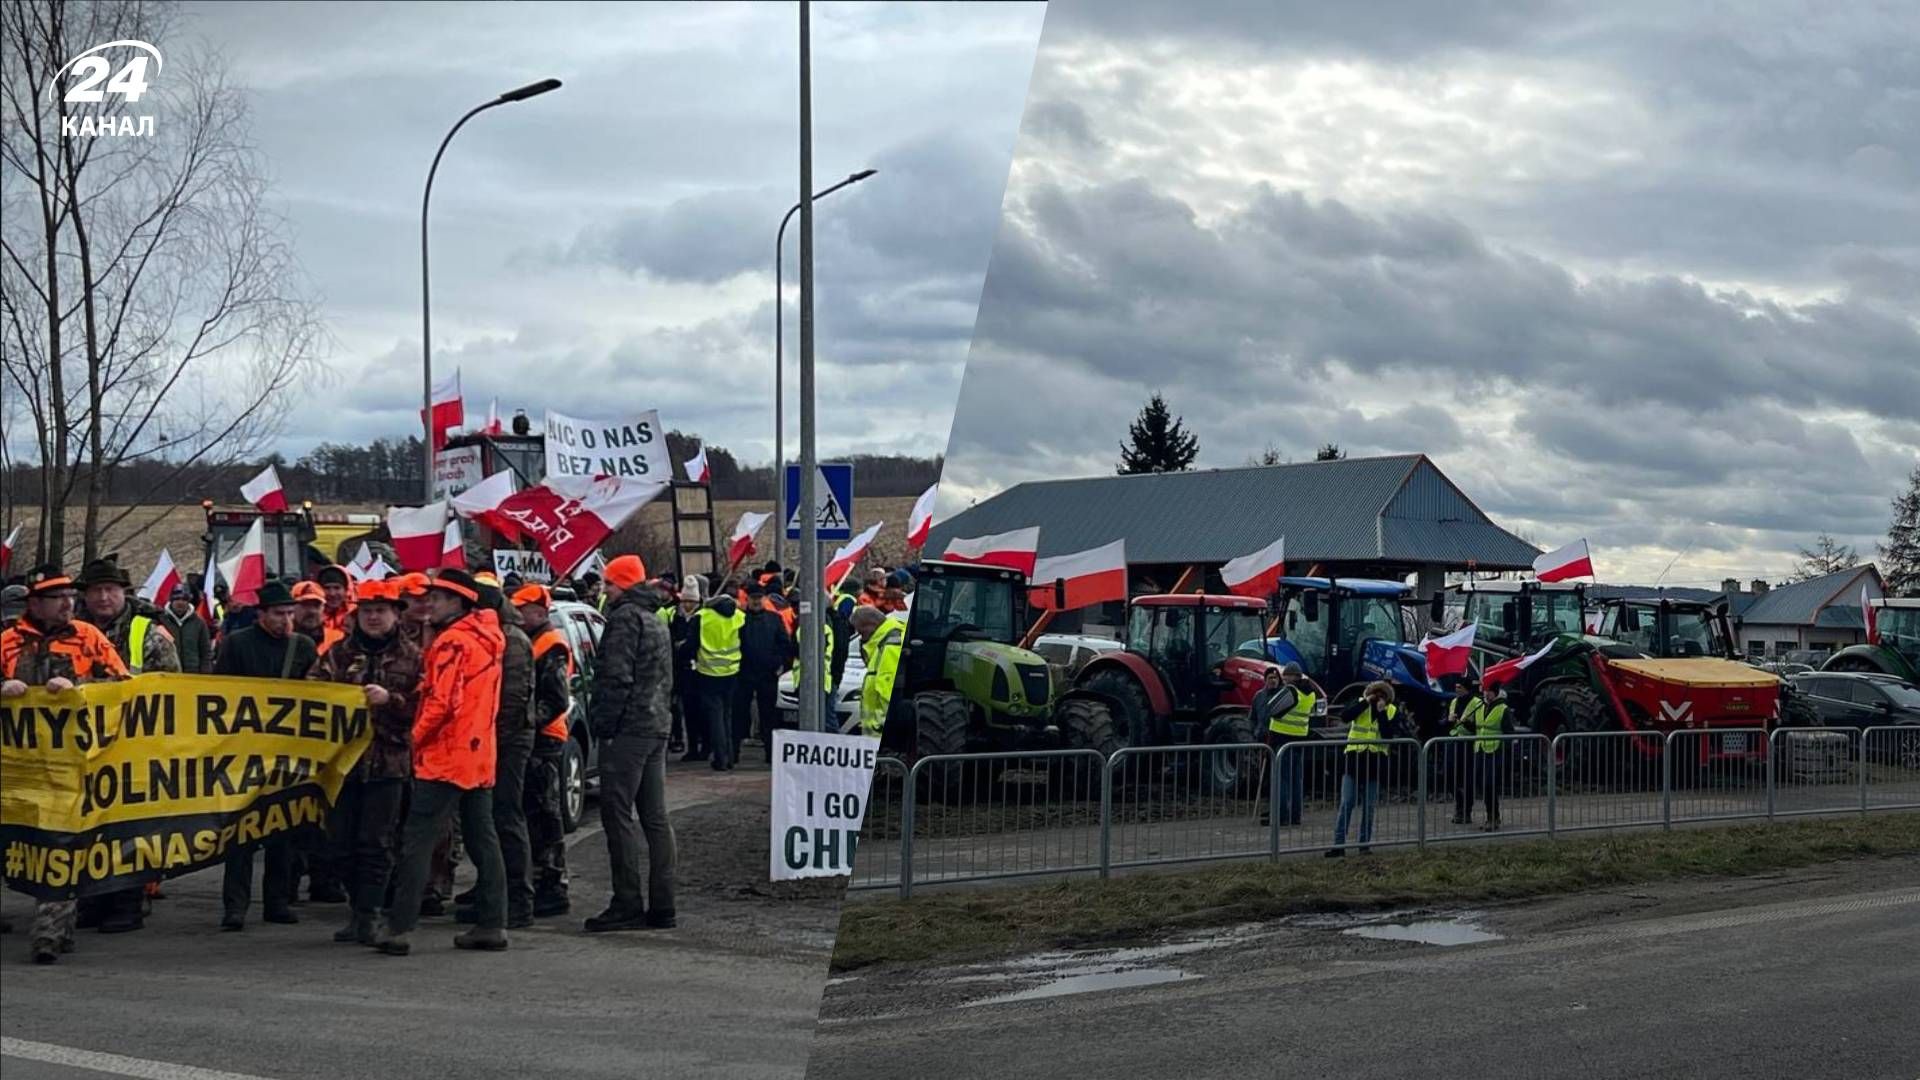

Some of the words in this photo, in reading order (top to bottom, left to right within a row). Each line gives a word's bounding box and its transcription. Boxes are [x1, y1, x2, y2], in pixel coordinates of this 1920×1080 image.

[548, 419, 576, 447] NIC
[581, 428, 596, 449] O
[603, 422, 653, 449] NAS
[557, 452, 592, 476] BEZ
[600, 454, 649, 476] NAS
[197, 694, 367, 745] RAZEM
[783, 743, 874, 770] PRACUJE
[807, 791, 814, 817] I
[824, 793, 860, 819] GO
